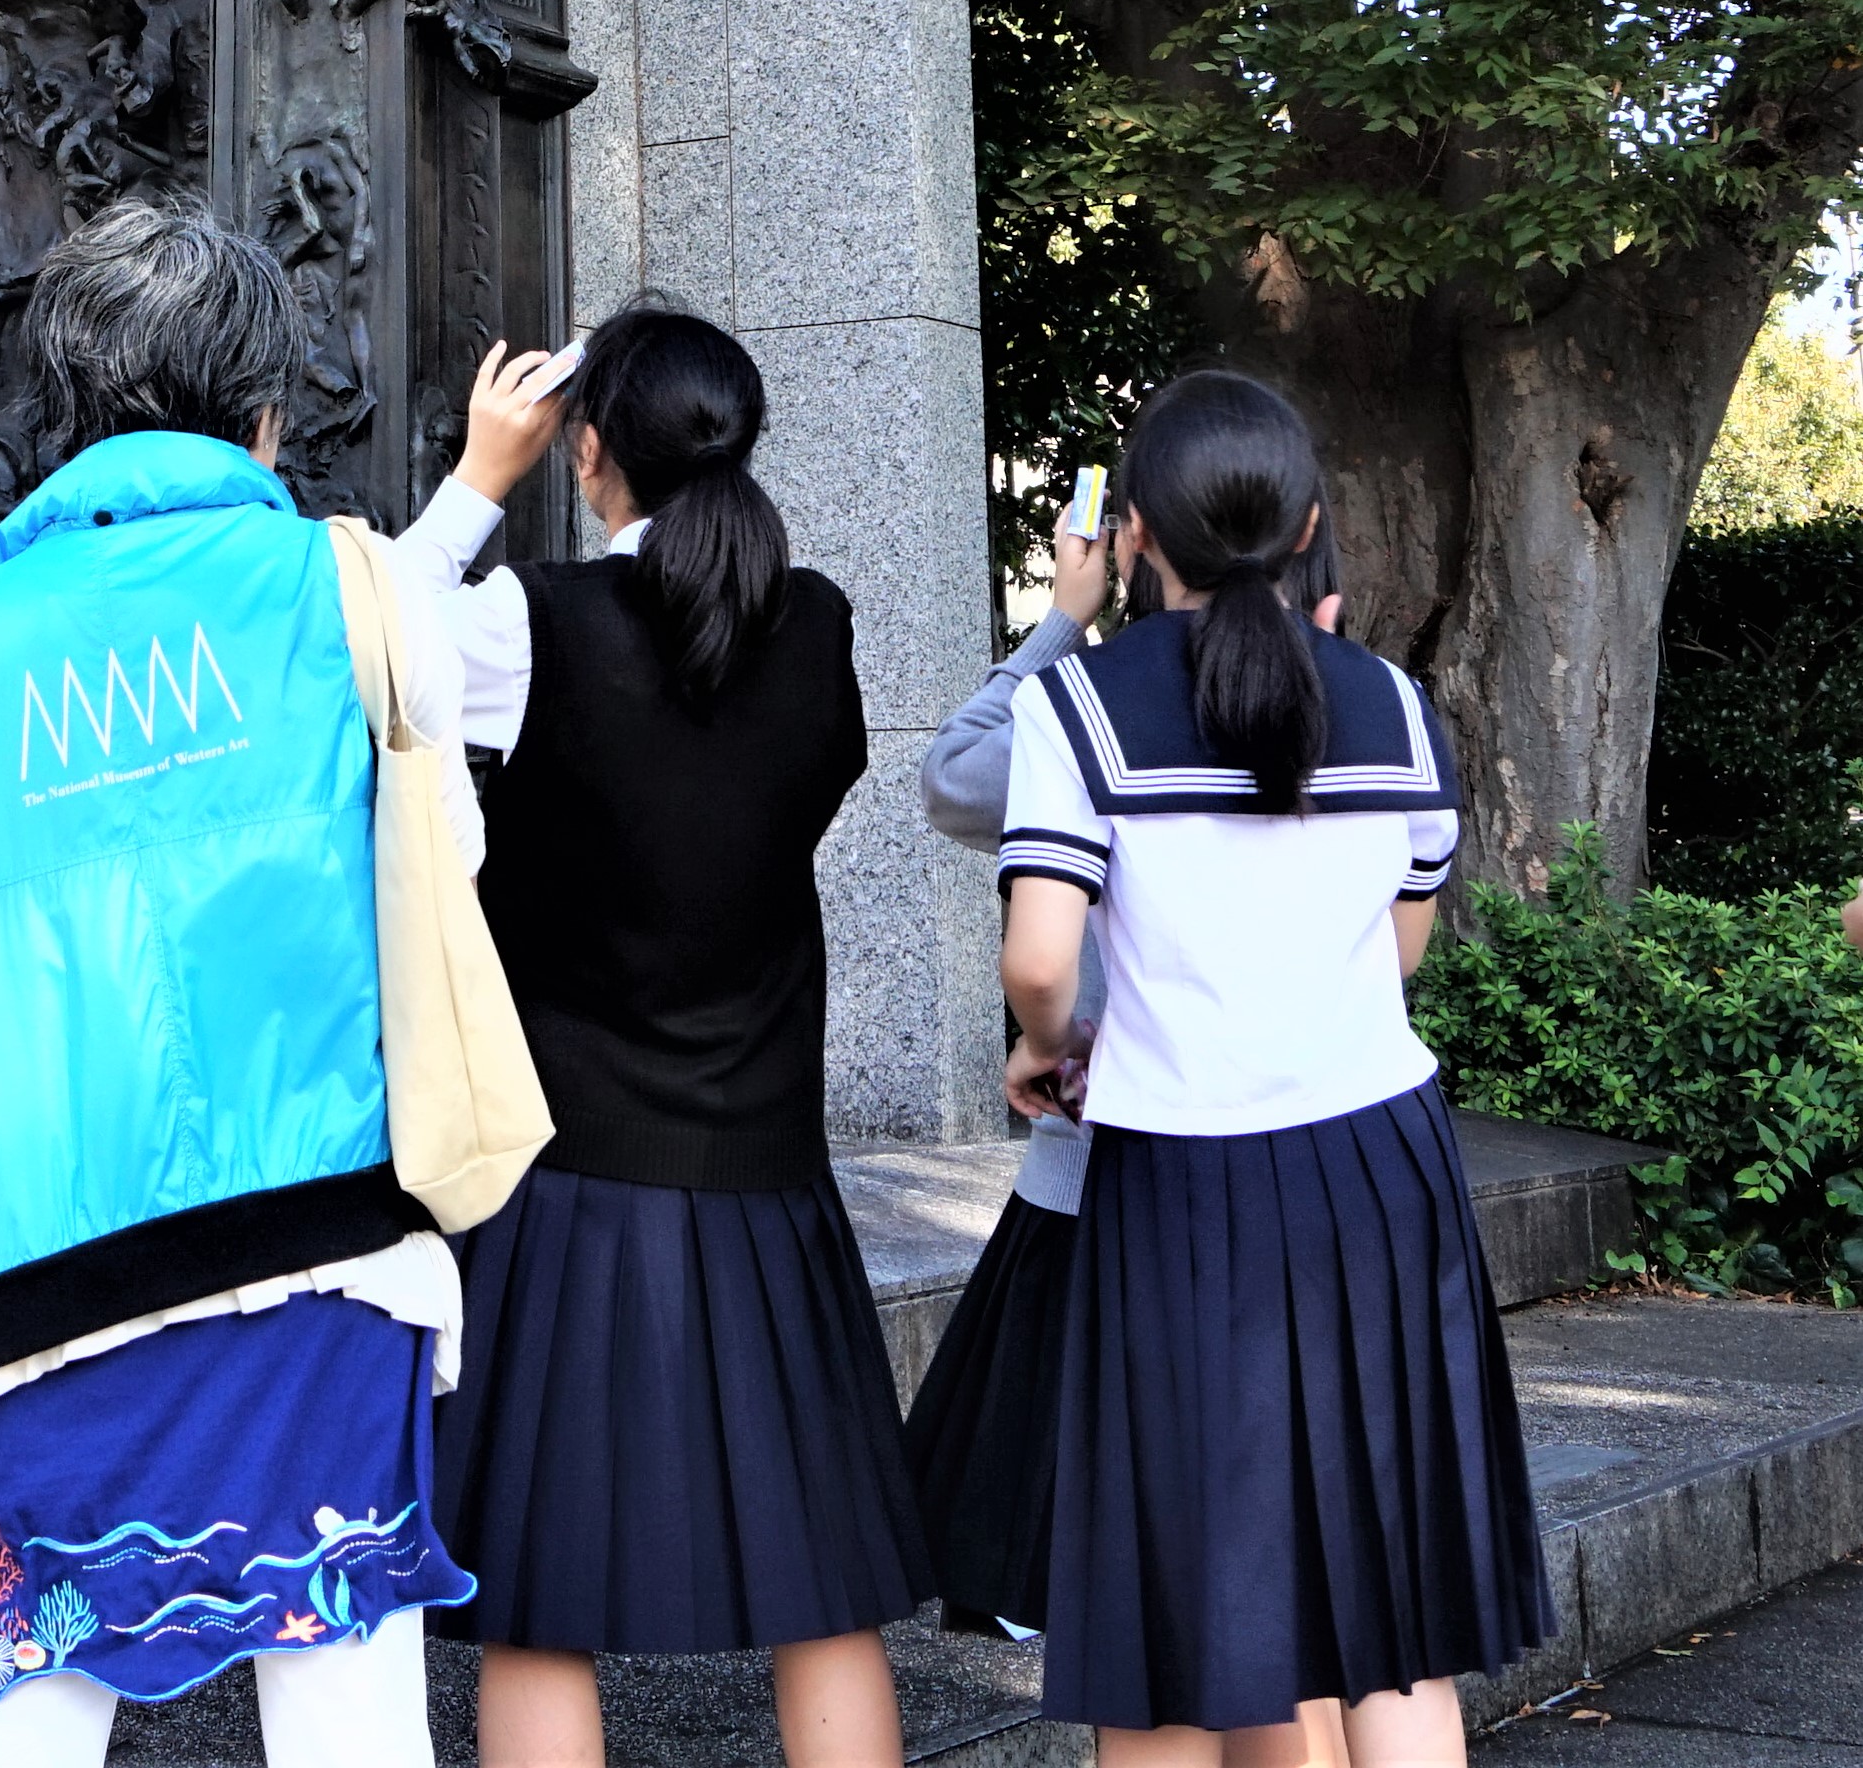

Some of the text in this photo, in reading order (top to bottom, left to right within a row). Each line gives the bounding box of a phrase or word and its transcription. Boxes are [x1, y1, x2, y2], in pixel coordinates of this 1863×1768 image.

[22, 737, 250, 809] The National Museum of Western Art
